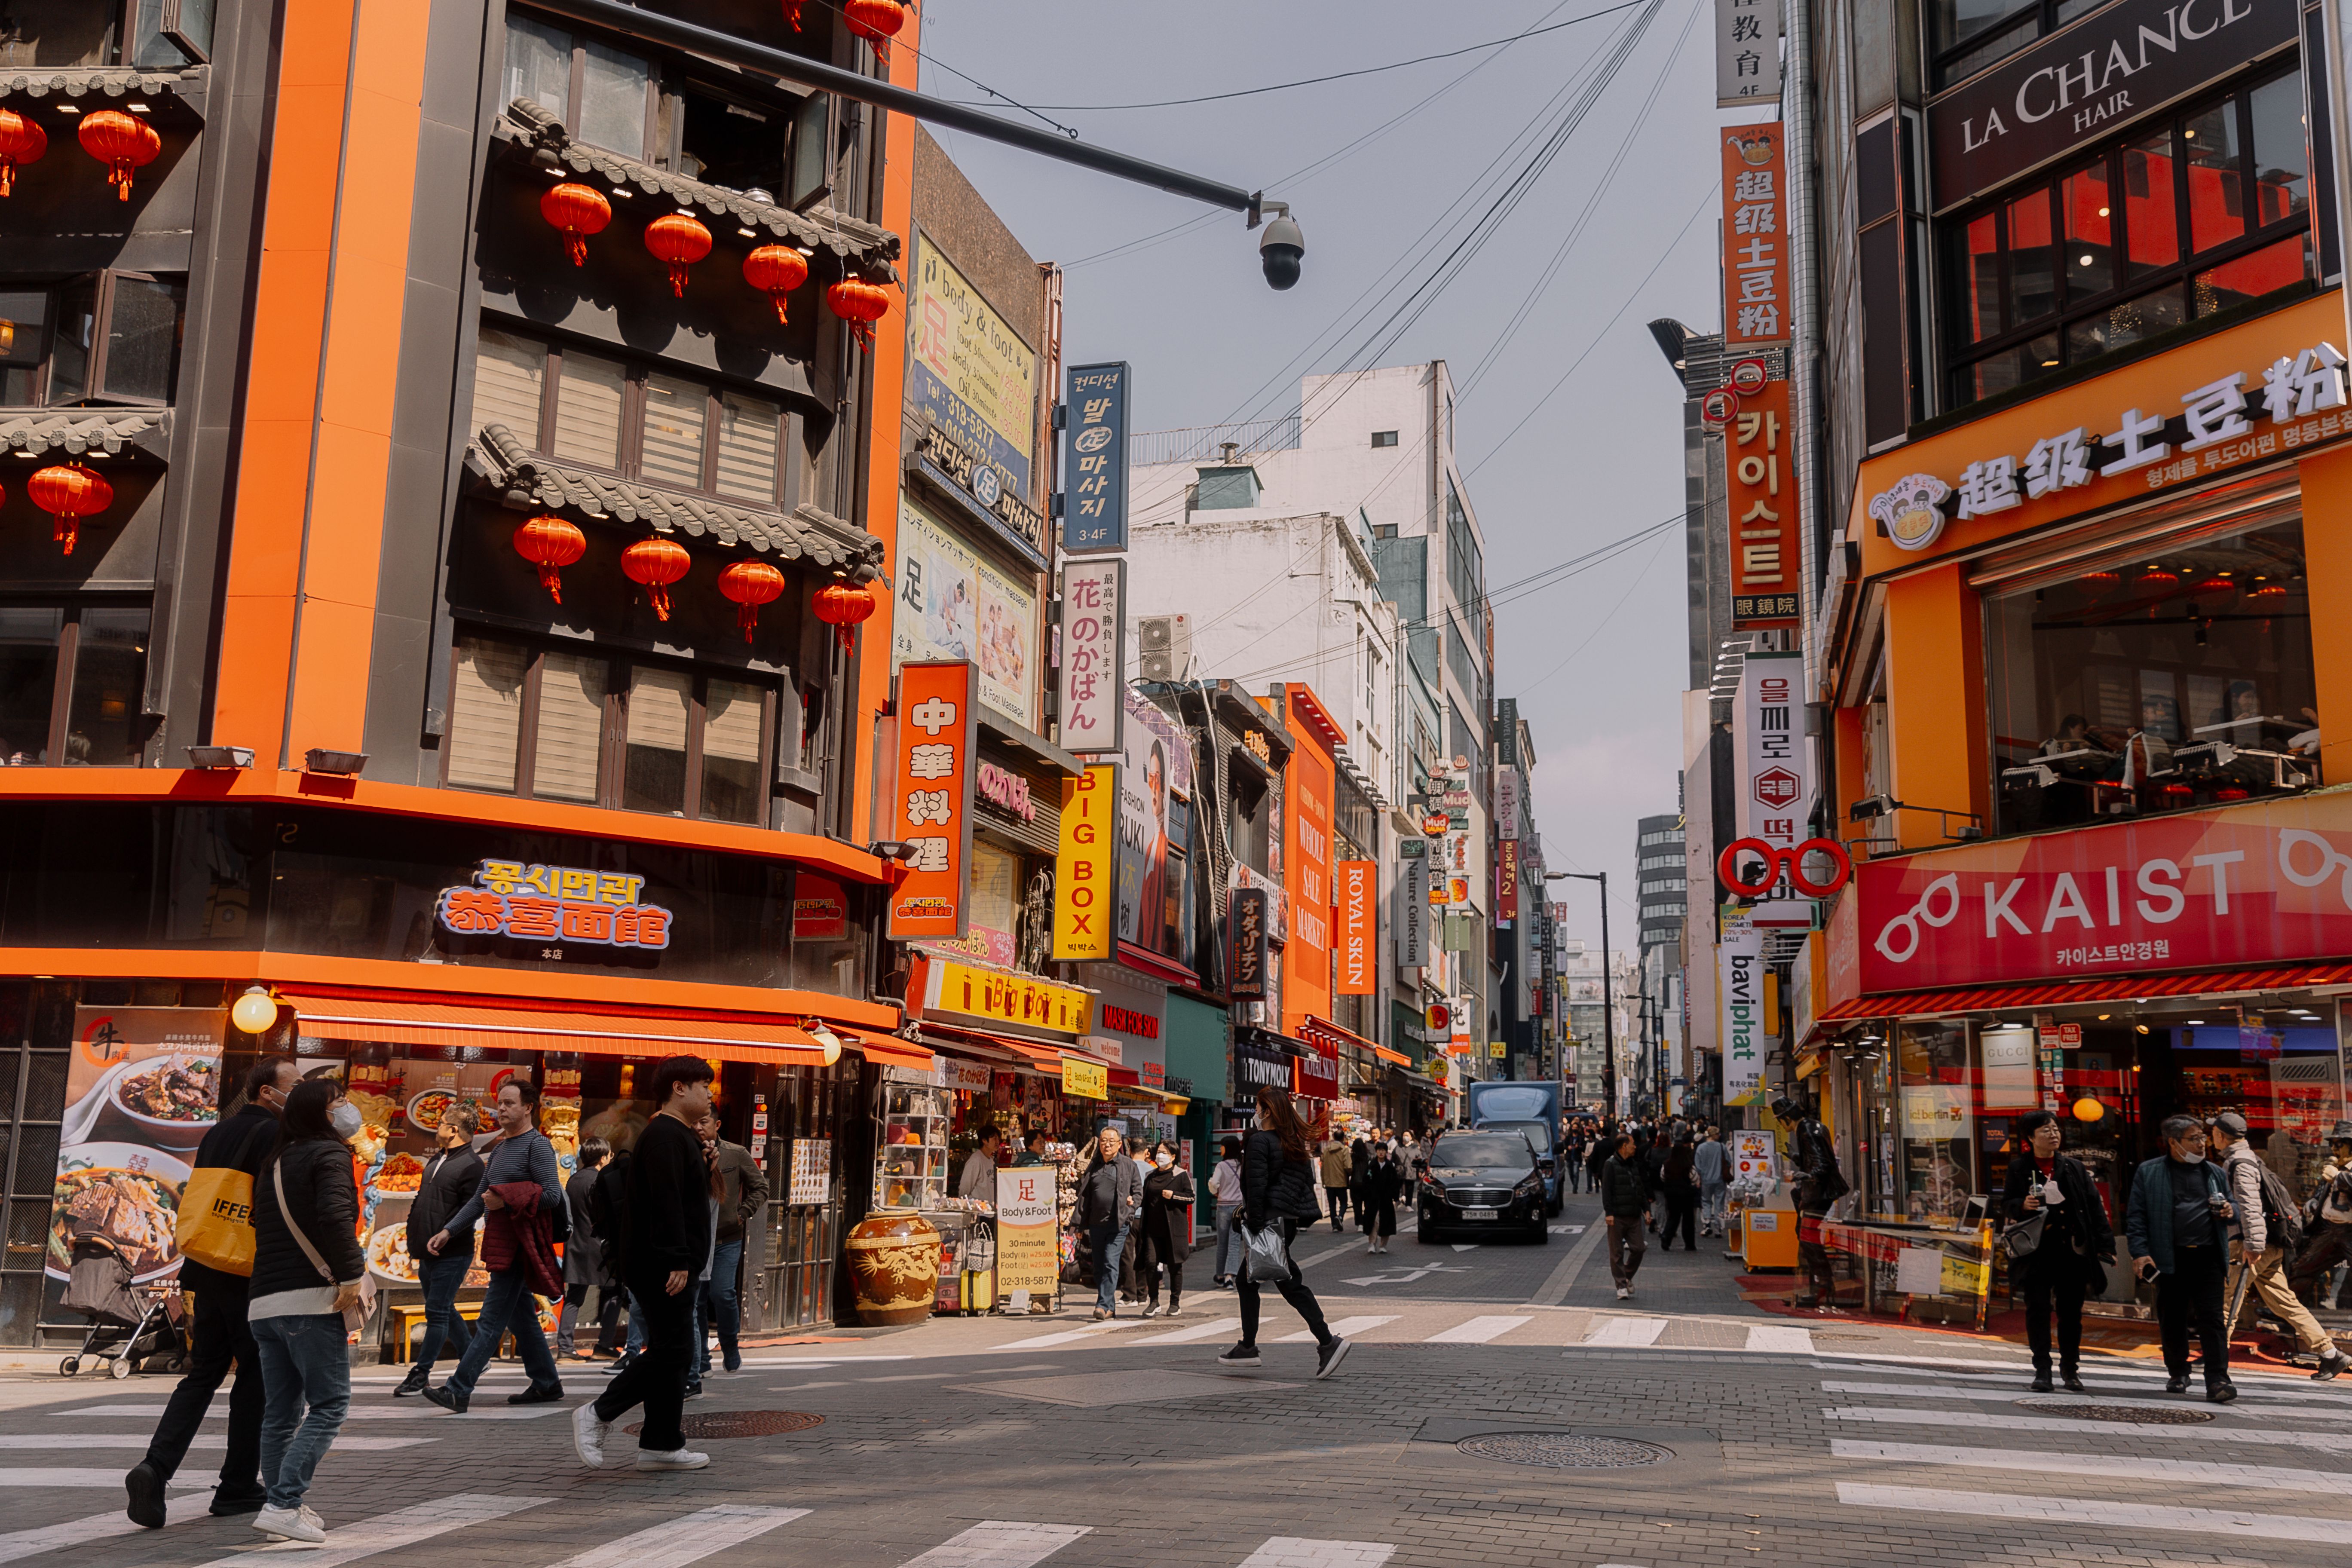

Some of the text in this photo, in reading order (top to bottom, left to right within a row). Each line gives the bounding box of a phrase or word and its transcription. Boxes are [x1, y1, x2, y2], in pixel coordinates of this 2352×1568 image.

[1731, 0, 1762, 77] 教育
[1740, 85, 1759, 96] 4F
[1962, 107, 2009, 155] LA
[2073, 90, 2134, 134] HAIR
[1733, 170, 1779, 337] 超级土豆粉
[918, 290, 949, 377] 足
[943, 269, 1013, 363] body & foot
[957, 326, 971, 352] foot
[953, 346, 971, 377] body
[959, 377, 970, 399] Oil
[1074, 373, 1119, 392] 컨디션
[926, 377, 939, 401] Tel
[948, 394, 994, 449] 318-5877
[1083, 398, 1112, 424] 발
[1958, 340, 2347, 520] 超级土豆粉
[928, 426, 1041, 545] 컨디션 足 마사지
[1078, 456, 1108, 517] 마사지
[2146, 457, 2198, 488] 형제들
[1737, 410, 1782, 585] 카이스트
[901, 556, 923, 614] 足
[978, 566, 1027, 609] condition massage
[1736, 597, 1795, 615] 眼鏡院
[1101, 574, 1114, 682] 最高で勝負します
[1068, 579, 1101, 730] 花のかばん
[905, 697, 956, 872] 中華料理
[1444, 793, 1470, 806] Mud
[1761, 780, 1794, 796] 국물
[1299, 815, 1325, 866] WHOLE
[1426, 818, 1446, 827] Mud
[1071, 771, 1096, 934] BIG BOX
[1303, 864, 1321, 905] SALE
[1502, 882, 1511, 895] 2
[1984, 850, 2244, 938] KAIST
[1296, 905, 1325, 952] MARKET
[1348, 868, 1364, 986] ROYAL SKIN
[1407, 861, 1418, 962] Nature Collection
[1506, 910, 1516, 918] 3F
[542, 948, 563, 960] 本店
[1068, 943, 1097, 952] 빅박스
[2057, 940, 2170, 967] 카이스트안경원
[993, 978, 1053, 1018] Big Box
[1730, 955, 1756, 1061] baviphat
[1105, 1004, 1159, 1039] MASK FOR SKIN
[92, 1022, 125, 1061] 牛
[1101, 1042, 1120, 1057] welcome
[1987, 1047, 2028, 1057] GUCCI
[958, 1067, 987, 1085] 花のかばん
[1065, 1066, 1072, 1088] 足
[1249, 1057, 1290, 1088] TONYMOLY
[1922, 1109, 1948, 1119] berlin
[1017, 1178, 1036, 1202] 足
[1001, 1276, 1054, 1286] 02-318-5877
